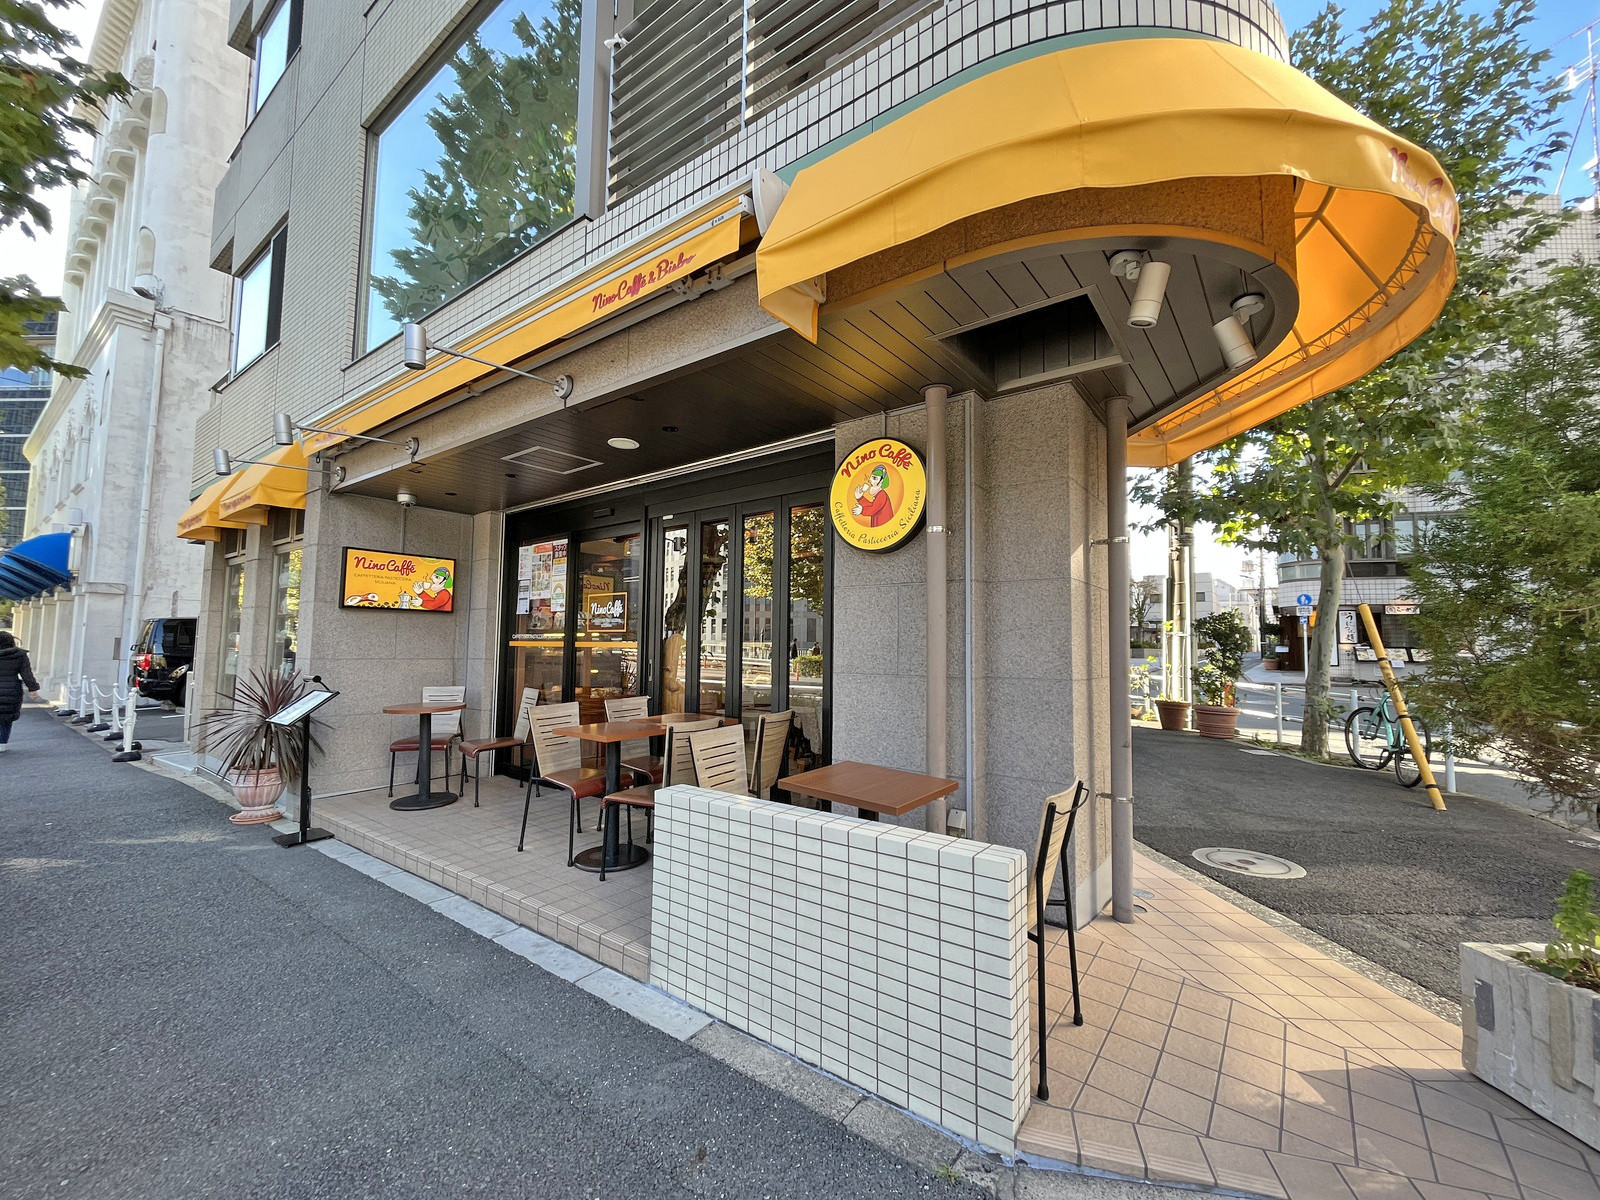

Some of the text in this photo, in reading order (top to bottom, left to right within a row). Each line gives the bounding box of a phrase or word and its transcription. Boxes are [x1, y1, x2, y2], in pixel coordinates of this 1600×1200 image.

[647, 270, 657, 284] &
[841, 449, 877, 478] Nino
[834, 489, 921, 545] Caffetteria Pasticceria Siciliana
